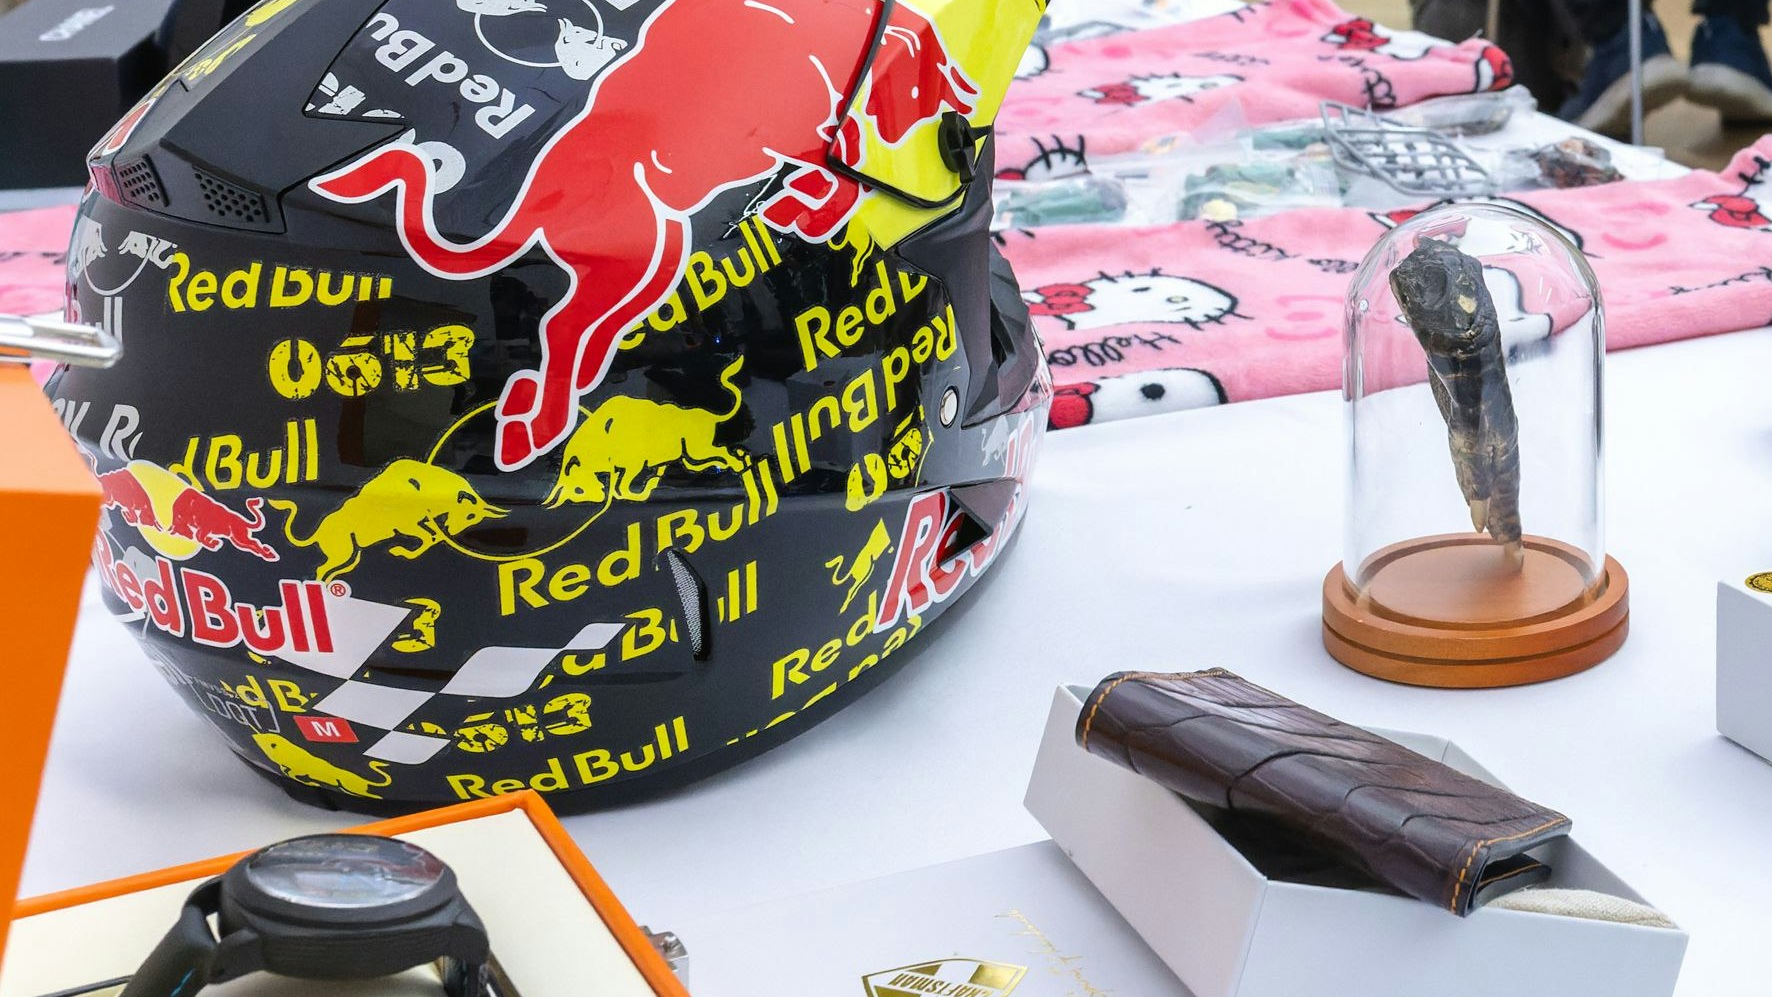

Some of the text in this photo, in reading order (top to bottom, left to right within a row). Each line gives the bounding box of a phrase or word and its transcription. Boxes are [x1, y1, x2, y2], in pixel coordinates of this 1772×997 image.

[404, 50, 536, 140] Red
[685, 214, 782, 312] Bull
[267, 323, 477, 401] 0613
[794, 259, 896, 373] Red
[882, 304, 958, 413] Red
[204, 418, 319, 491] Bull
[772, 368, 879, 485] Bull
[94, 534, 186, 638] Red
[498, 456, 779, 617] Red Bull
[772, 590, 878, 701] Red
[311, 721, 340, 738] M
[573, 715, 690, 786] Bull
